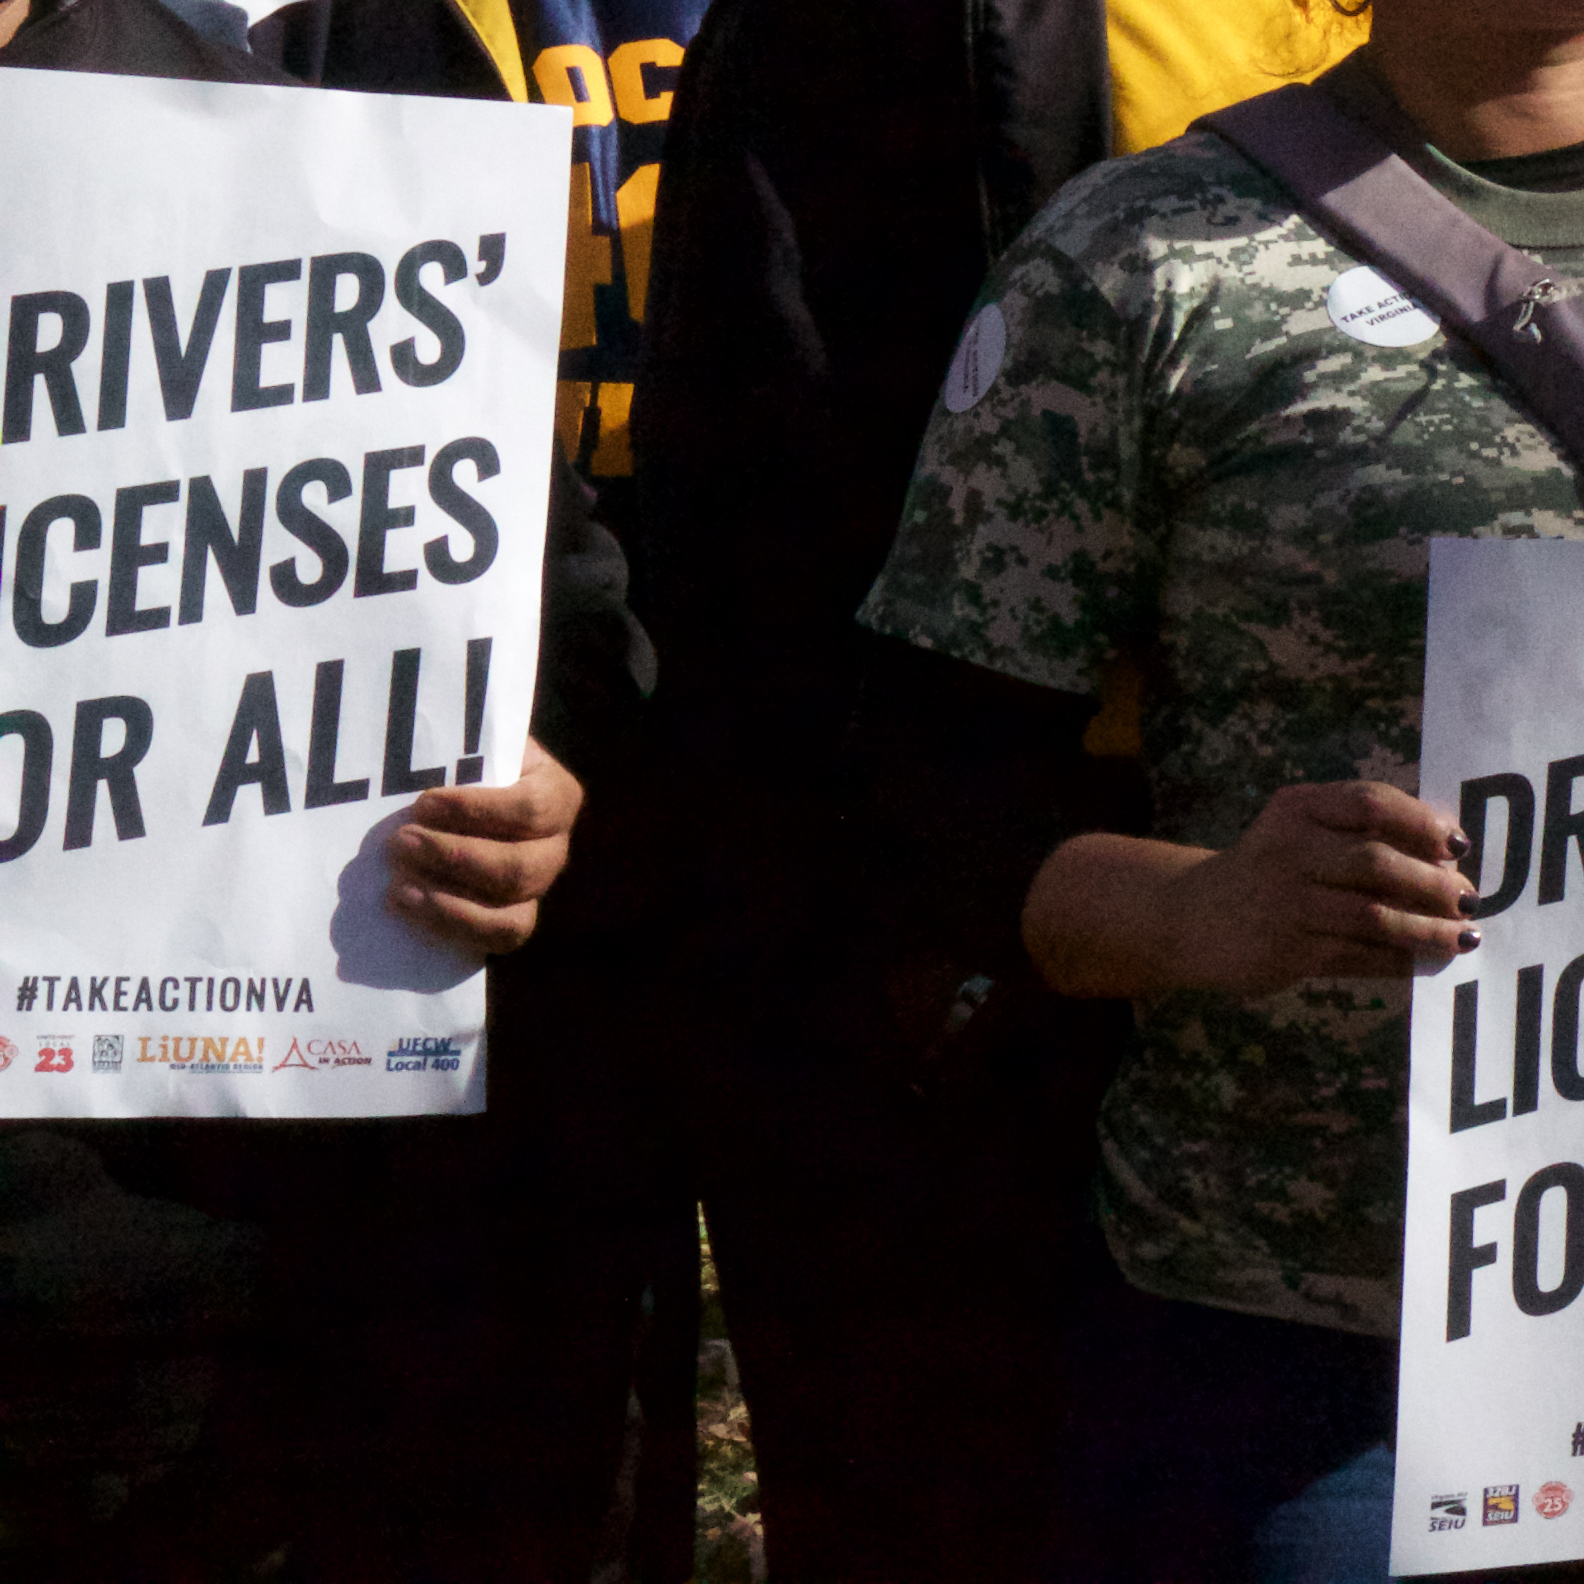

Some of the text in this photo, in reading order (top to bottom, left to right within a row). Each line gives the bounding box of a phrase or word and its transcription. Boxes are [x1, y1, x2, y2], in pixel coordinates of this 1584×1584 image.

[532, 37, 686, 127] OC
[1340, 305, 1375, 324] TAKE
[1365, 304, 1416, 326] VIRGINI
[2, 232, 507, 444] RIVERS'
[0, 437, 503, 654] CENSES
[0, 636, 493, 864] OR ALL!
[16, 975, 316, 1013] #TAKEACTIONVA
[137, 1034, 265, 1063] LiUNA!
[306, 1038, 362, 1056] CASA
[397, 1037, 453, 1053] UFCW
[34, 1047, 75, 1074] 23
[386, 1057, 461, 1072] Local 400
[1486, 1510, 1514, 1522] SEIU
[1543, 1497, 1563, 1513] 25
[1428, 1517, 1466, 1533] SEIU
